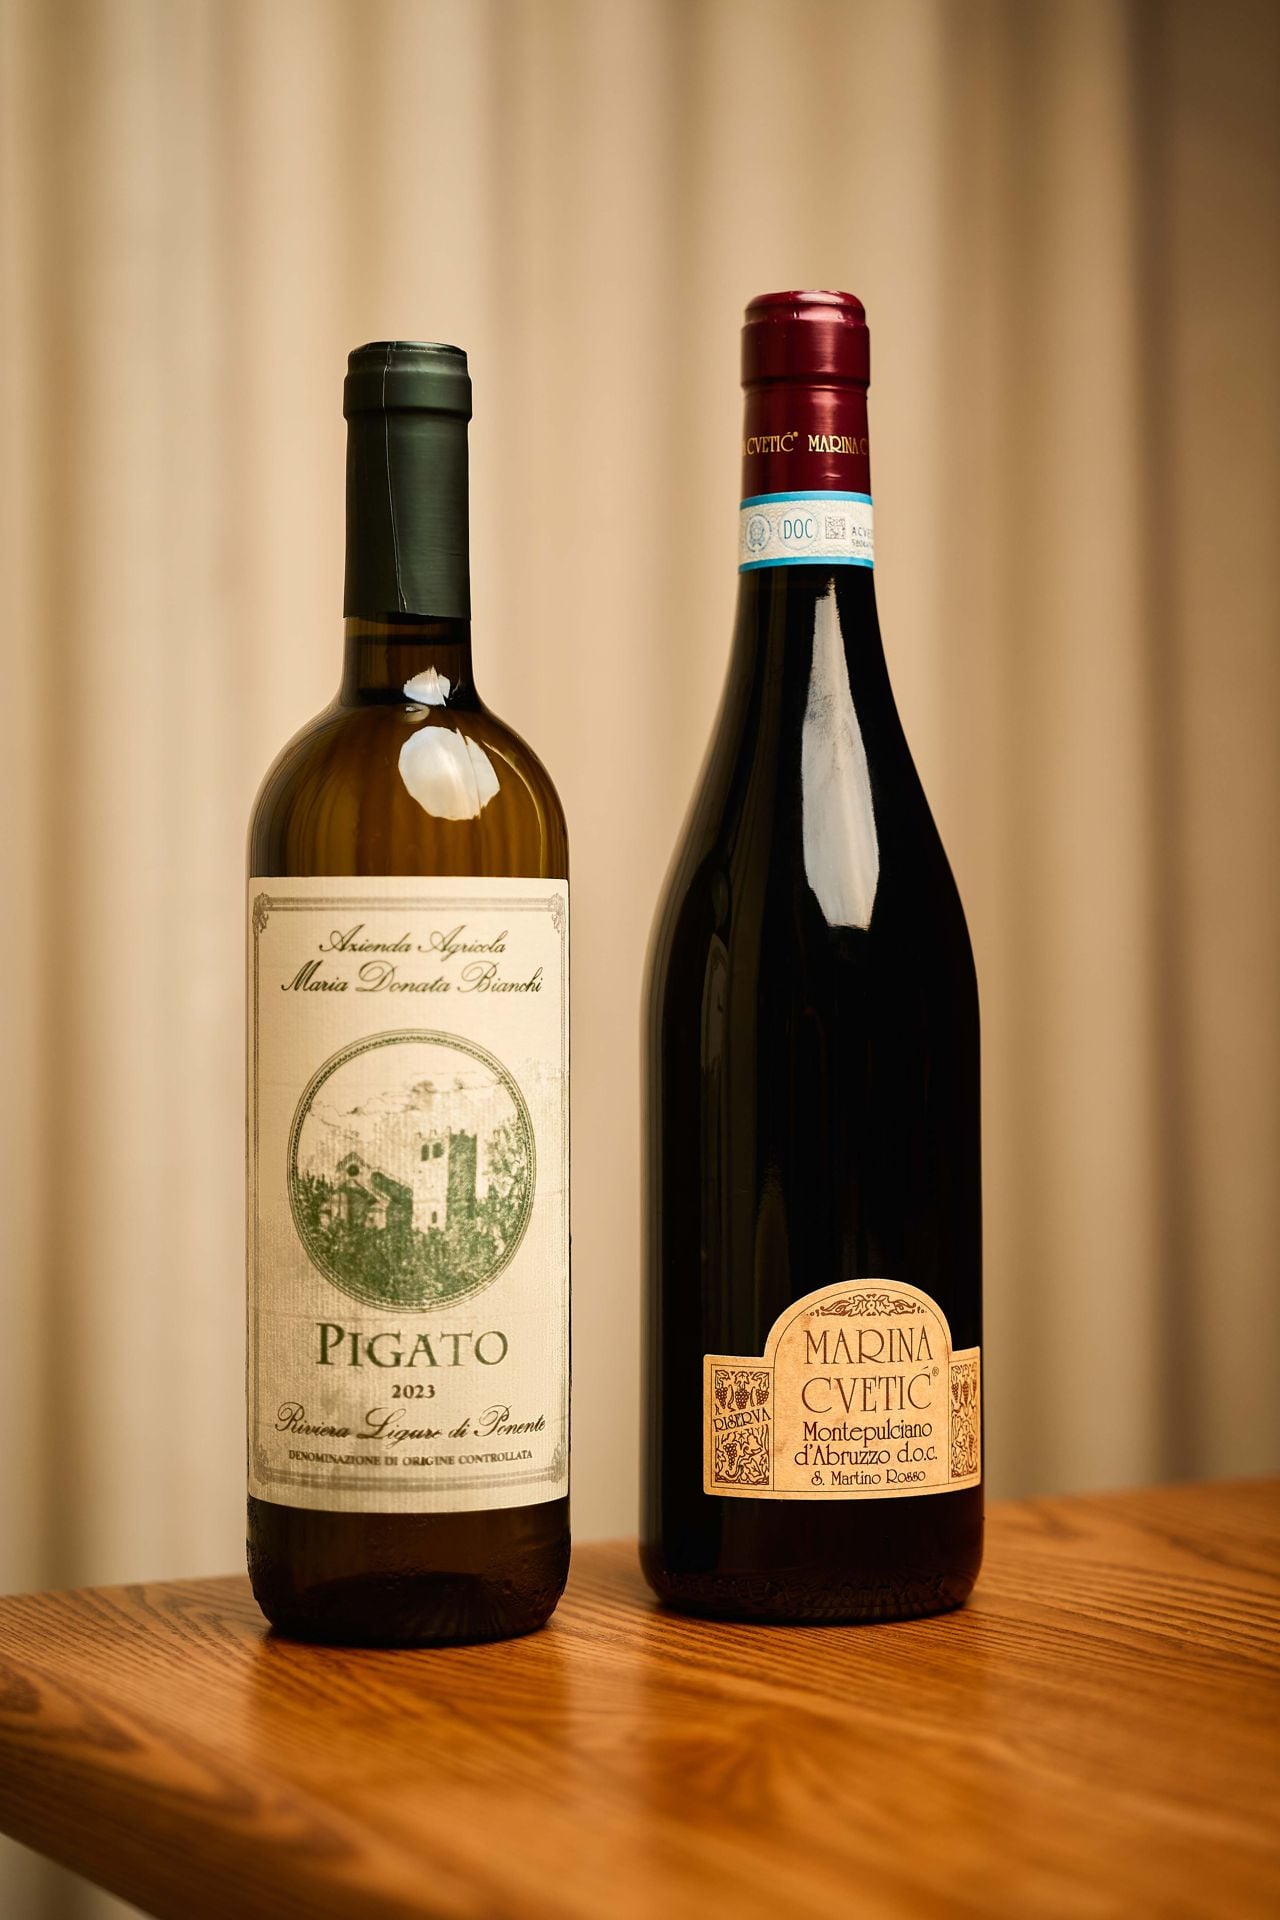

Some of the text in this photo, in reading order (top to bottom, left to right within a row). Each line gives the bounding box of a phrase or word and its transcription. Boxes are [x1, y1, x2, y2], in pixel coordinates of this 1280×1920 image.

[807, 434, 859, 455] MARINA
[783, 518, 813, 540] DOC
[319, 923, 508, 962] Azienda Agricola
[280, 959, 543, 993] Maria Donata Bianchi
[315, 1322, 508, 1369] PIGATO
[803, 1325, 933, 1366] MARINA
[391, 1384, 436, 1400] 2023
[274, 1401, 546, 1449] Riviera Ligure di Ponente
[713, 1407, 772, 1433] RISERVA
[802, 1418, 933, 1449] Montepulciano
[288, 1449, 533, 1467] DENOMINAZIONE DI ORIGINE CONTROLLATA
[794, 1440, 938, 1466] d'Abruzzo d.o.c.
[810, 1468, 926, 1486] S. Martino Rosso
